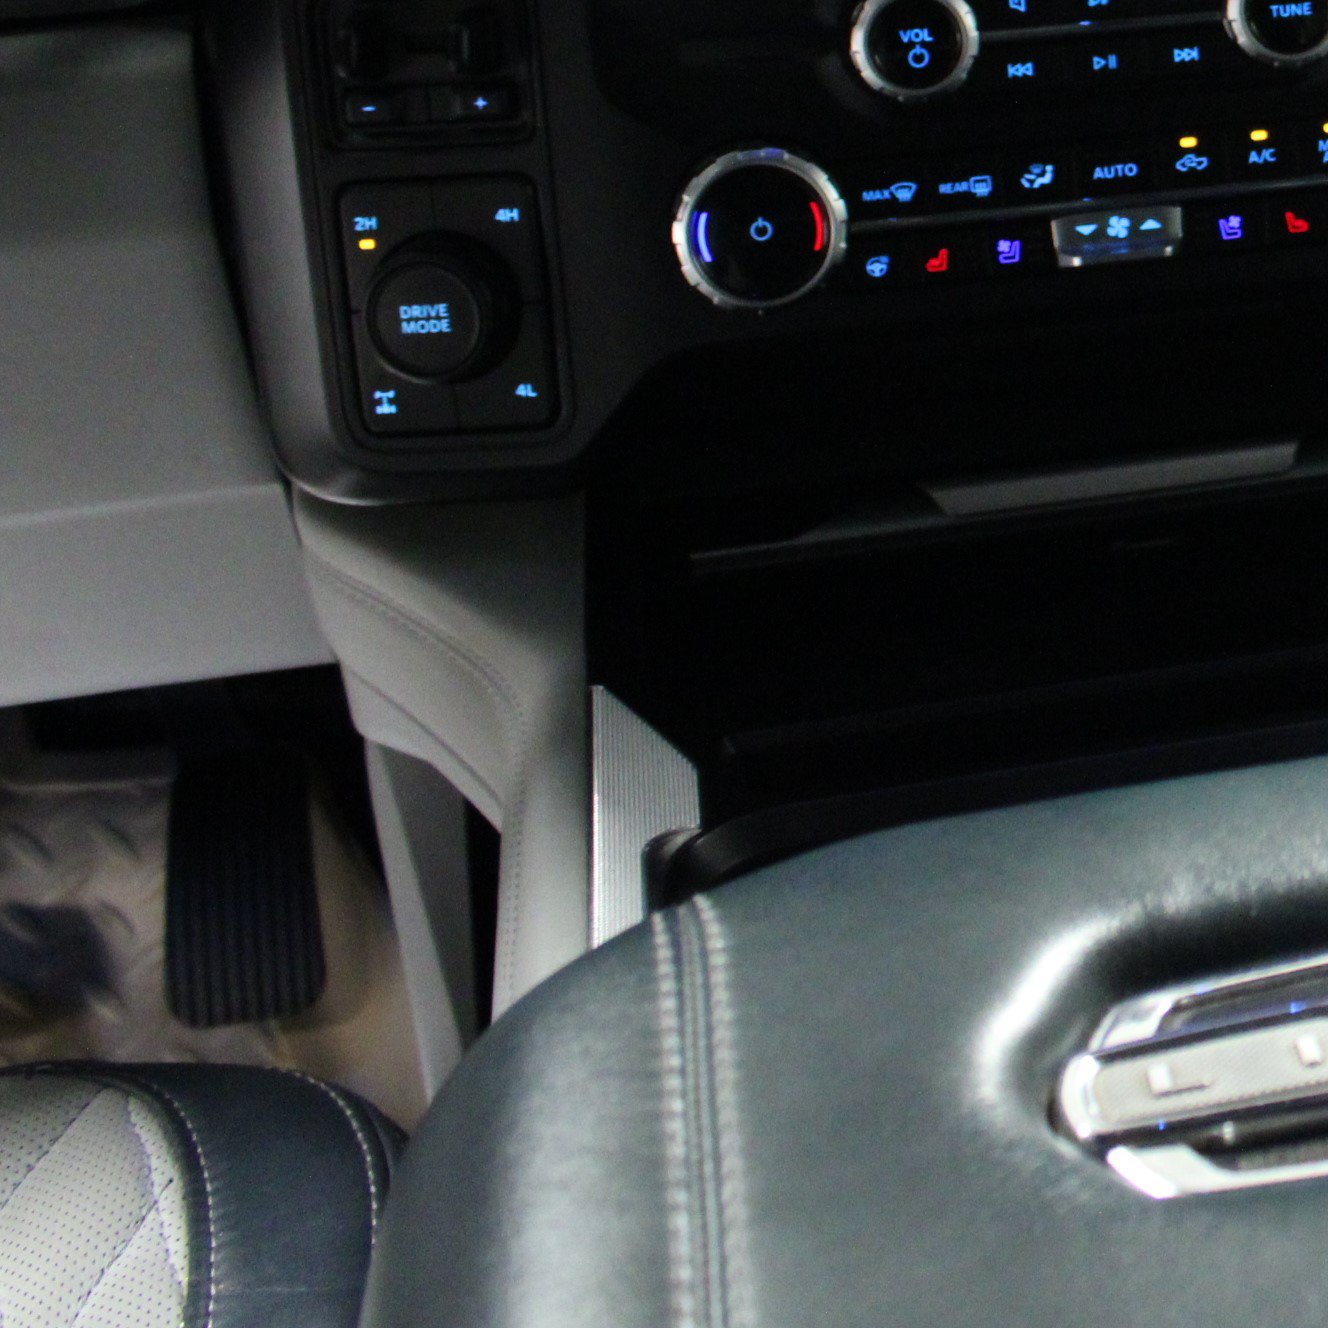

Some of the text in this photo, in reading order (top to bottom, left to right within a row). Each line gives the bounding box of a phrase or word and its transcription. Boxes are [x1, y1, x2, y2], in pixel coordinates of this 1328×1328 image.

[1269, 2, 1313, 18] TUNE
[899, 30, 934, 44] VOL
[1248, 148, 1277, 164] A/C
[1092, 161, 1139, 180] AUTO
[862, 188, 890, 202] MAX
[938, 180, 969, 195] REAR
[494, 207, 520, 222] 4H
[353, 216, 378, 232] 2H
[400, 303, 450, 319] DRIVE
[401, 319, 451, 334] MODE
[515, 383, 538, 398] 4L
